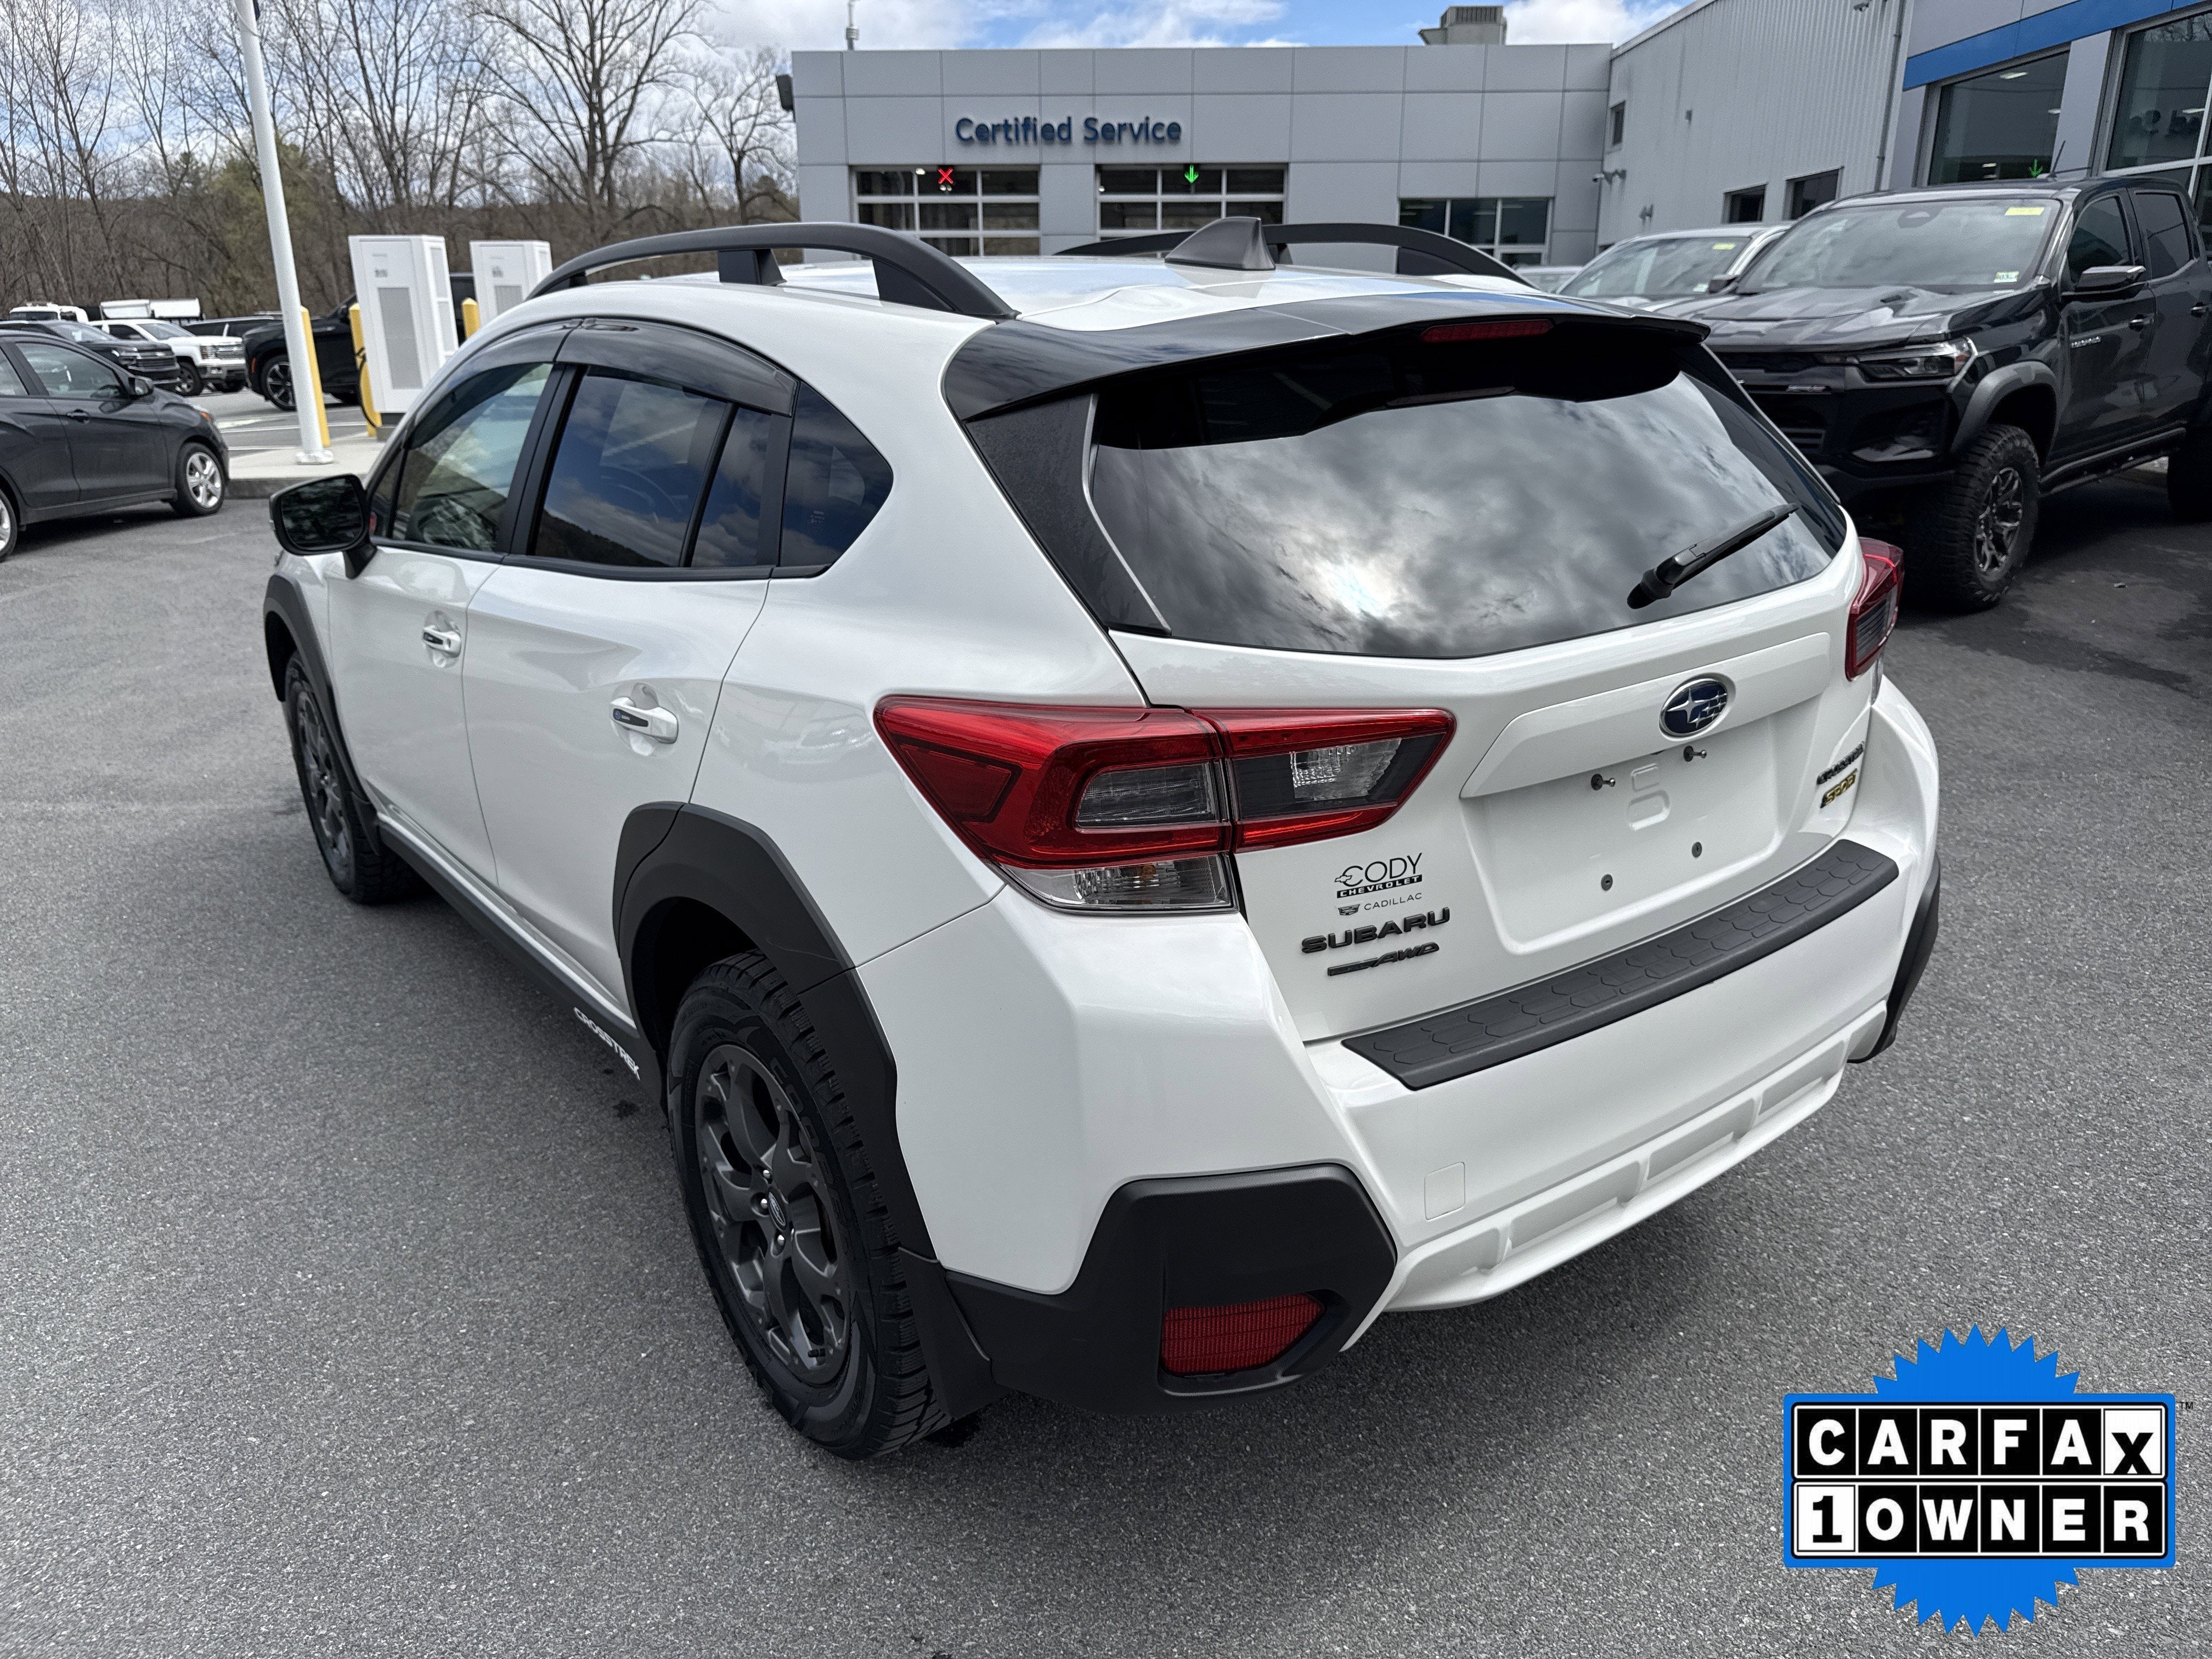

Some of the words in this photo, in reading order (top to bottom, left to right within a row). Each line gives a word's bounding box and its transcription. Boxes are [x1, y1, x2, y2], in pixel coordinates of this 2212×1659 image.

[956, 116, 1072, 144] Certified
[1083, 116, 1182, 144] Service
[1342, 853, 1422, 887] CODY
[1340, 876, 1421, 897] CHEVROLET
[1364, 893, 1422, 911] CADILLAC
[1302, 907, 1450, 953] SUBARU
[1372, 941, 1440, 967] AWD
[574, 1007, 641, 1081] CROSSTREK
